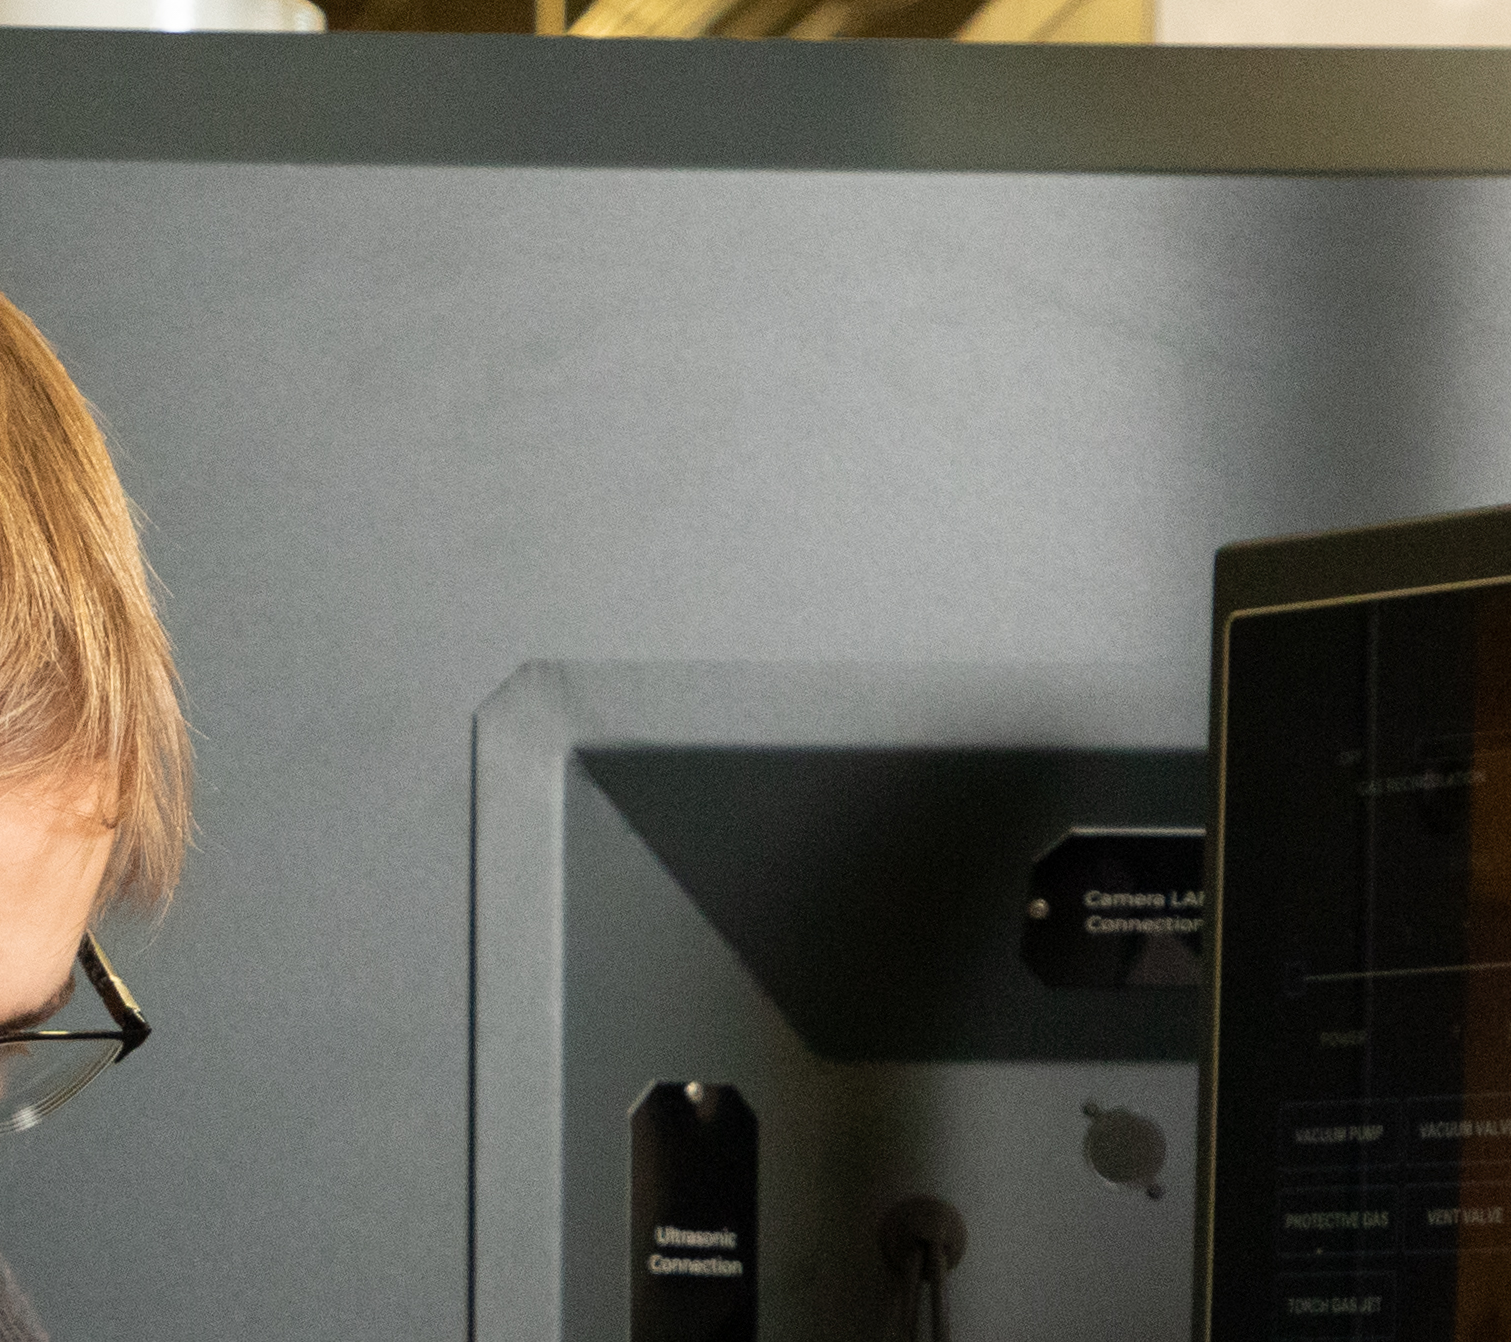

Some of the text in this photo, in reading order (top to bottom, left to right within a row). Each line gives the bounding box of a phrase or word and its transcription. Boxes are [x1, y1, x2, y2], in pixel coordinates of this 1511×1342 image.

[1083, 889, 1165, 907] Camera
[1361, 1210, 1390, 1229] GAS
[1461, 1206, 1504, 1226] VALVE
[655, 1225, 737, 1248] Ultrasonic
[648, 1254, 743, 1276] Connection
